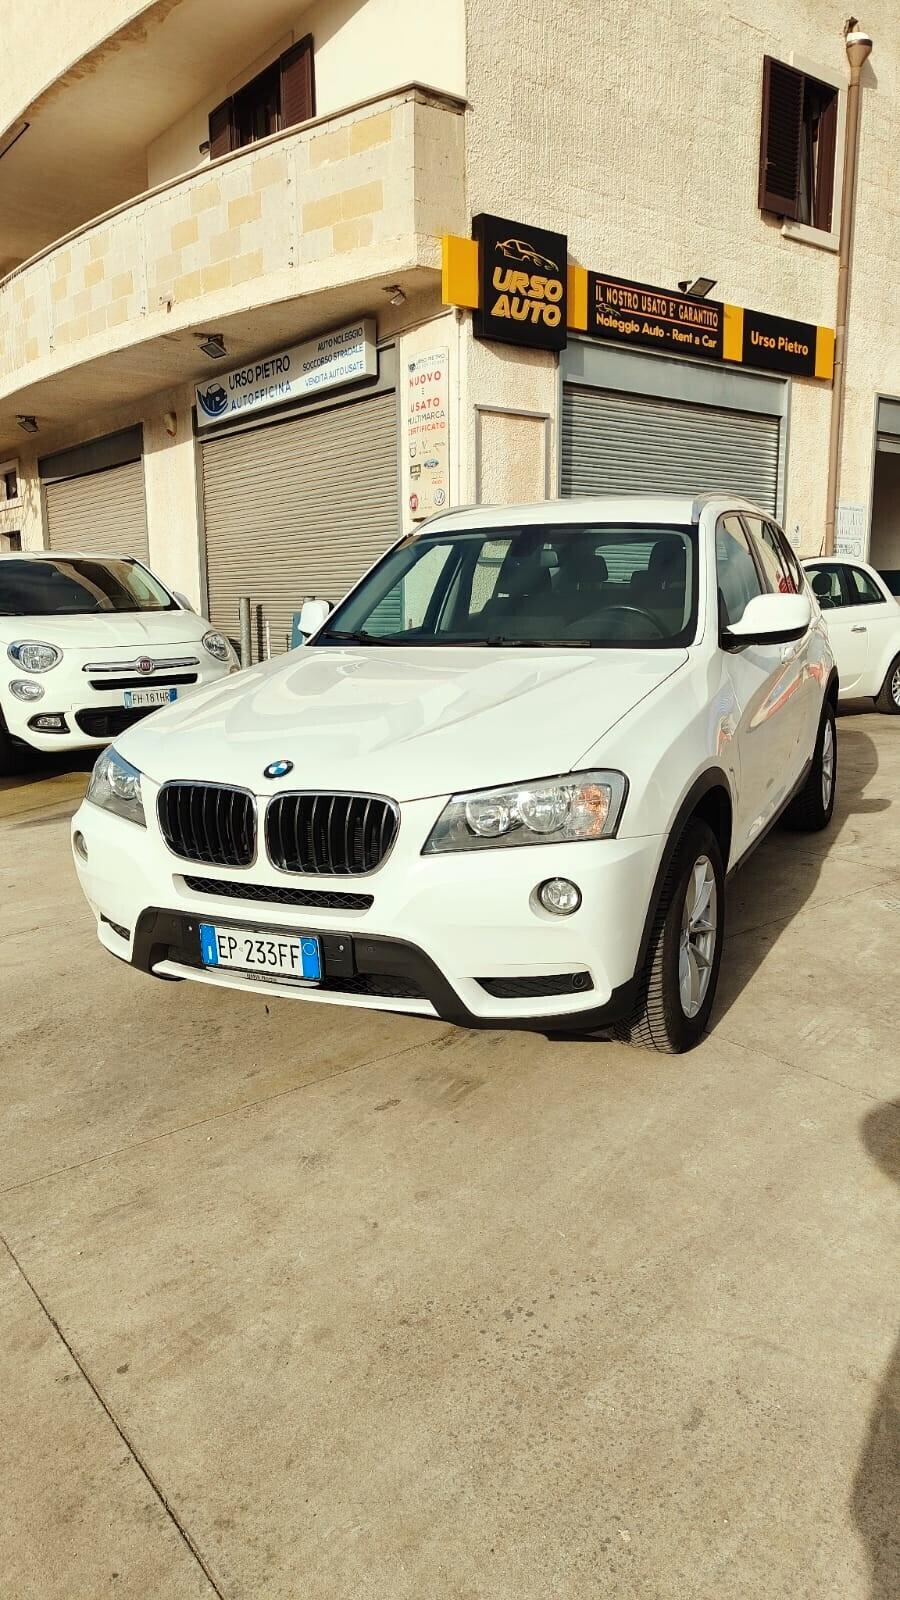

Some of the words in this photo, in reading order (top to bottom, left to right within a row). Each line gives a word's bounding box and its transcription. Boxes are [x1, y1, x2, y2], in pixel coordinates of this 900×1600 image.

[492, 266, 563, 302] URSO
[490, 294, 562, 327] AUTO
[595, 284, 604, 302] IL
[606, 287, 639, 310] NOSTRO
[641, 295, 667, 316] USATO
[678, 304, 719, 327] GARANTITO
[317, 338, 333, 352] AUTO
[333, 327, 363, 346] NOLEGGIO
[596, 312, 640, 334] Noleggio
[642, 322, 665, 338] Auto
[672, 328, 693, 344] Rent
[694, 336, 700, 345] a
[702, 334, 718, 348] Car
[751, 330, 776, 349] Urso
[777, 336, 809, 356] Pietro
[302, 354, 333, 372] SOCCORSO
[333, 342, 364, 361] STRADALE
[228, 368, 254, 390] URSO
[255, 355, 291, 381] PIETRO
[304, 373, 329, 387] VENDITA
[328, 366, 345, 380] AUTO
[344, 360, 364, 374] USATE
[409, 370, 442, 389] NUOVO
[231, 380, 292, 411] AUTOFFICINA
[410, 397, 440, 413] USATO
[408, 410, 445, 426] MULTIMARCA
[408, 421, 446, 436] CERTIFICATO
[217, 934, 238, 960] EP
[244, 939, 300, 969] 233FF
